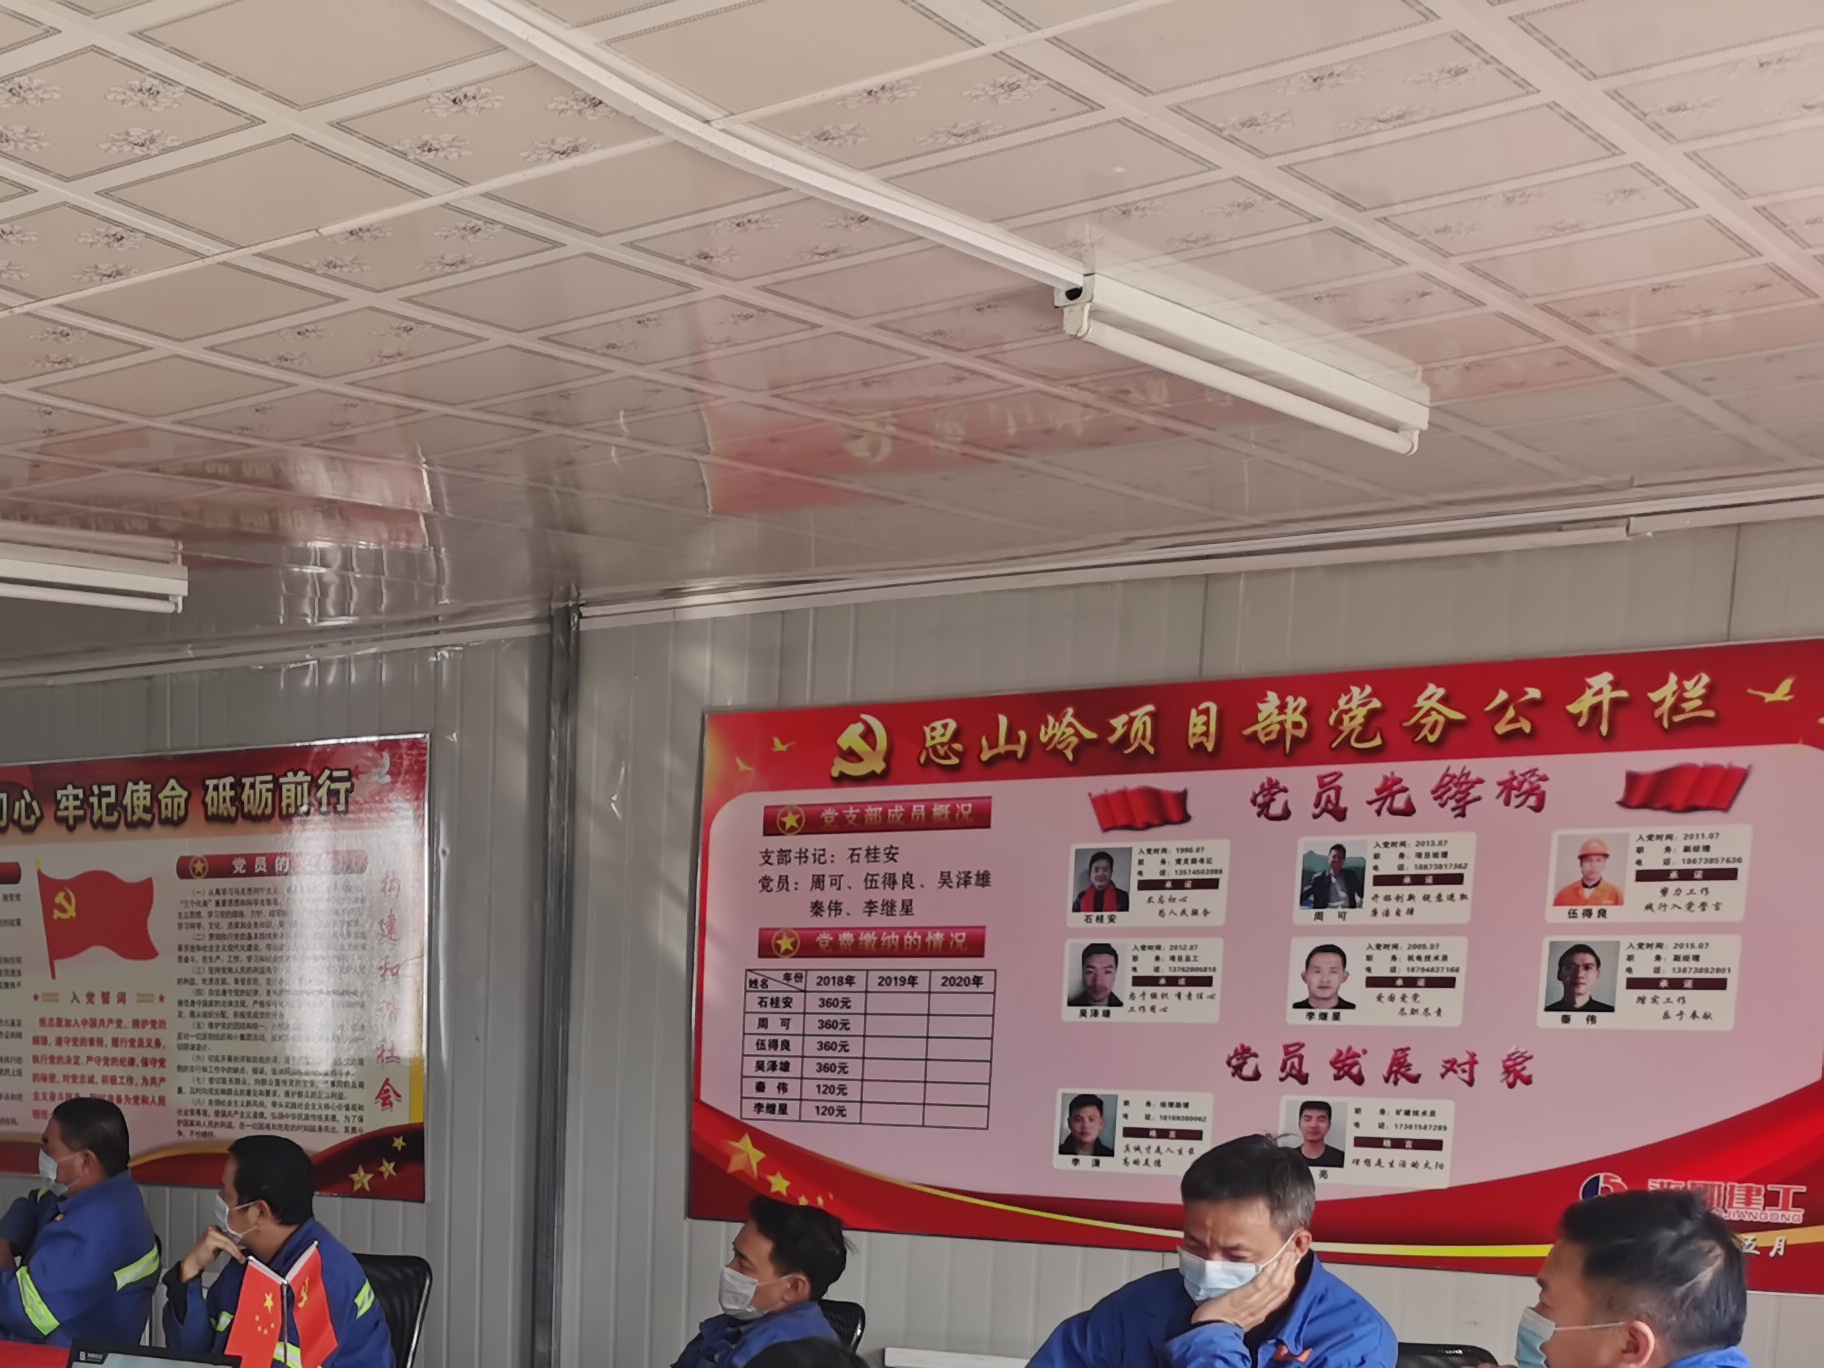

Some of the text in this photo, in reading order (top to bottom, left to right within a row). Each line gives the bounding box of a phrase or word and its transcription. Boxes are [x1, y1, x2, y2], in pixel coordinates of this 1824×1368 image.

[919, 671, 1720, 766] 思山岭项目部党务公开栏
[55, 777, 190, 829] 牢记使命
[204, 768, 355, 820] 砥砺前行
[1250, 764, 1551, 822] 党员先锋榜
[759, 845, 900, 866] 支部书记：石桂安
[748, 978, 769, 989] 姓名
[782, 971, 804, 983] 年份
[816, 974, 984, 988] 2018年 2019年 2020年
[818, 997, 852, 1009] 360元
[817, 1018, 851, 1031] 360元
[816, 1040, 850, 1052] 360元
[815, 1061, 849, 1074] 360元
[1226, 1041, 1535, 1089] 党员发展对象
[816, 1083, 848, 1096] 120元
[814, 1105, 847, 1118] 120元
